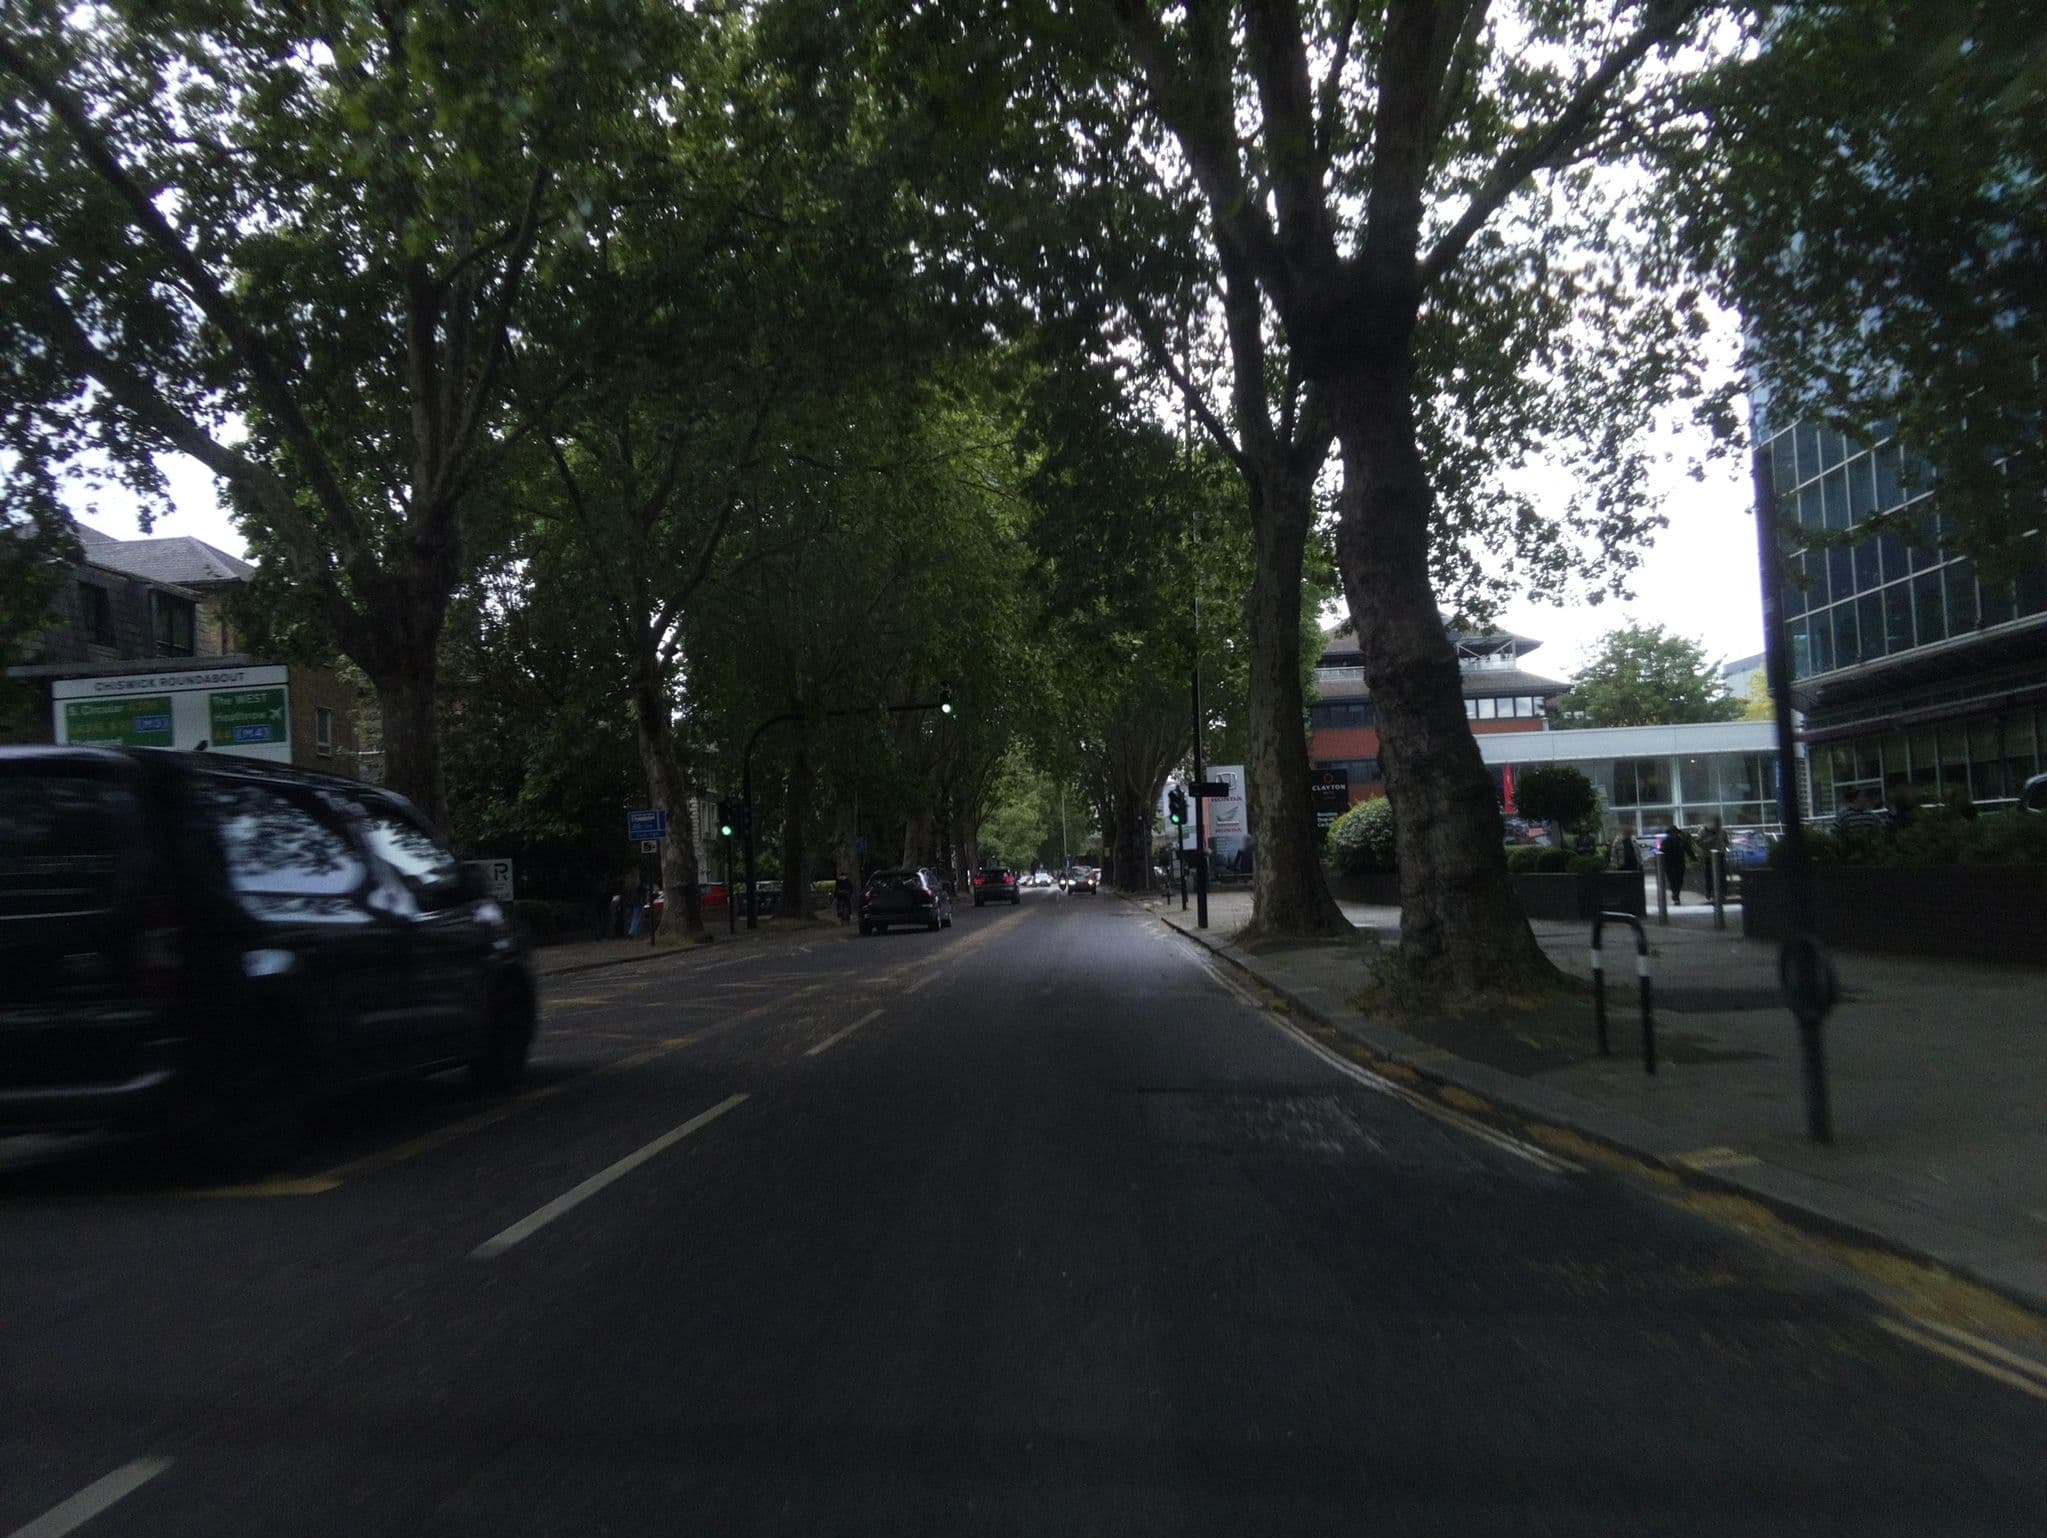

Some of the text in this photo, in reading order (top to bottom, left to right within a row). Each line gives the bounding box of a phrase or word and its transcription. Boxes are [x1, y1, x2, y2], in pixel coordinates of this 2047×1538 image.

[94, 672, 245, 692] CHISWICK ROUNDABOUT
[234, 693, 268, 704] WEST
[1311, 783, 1346, 791] CLAYTON
